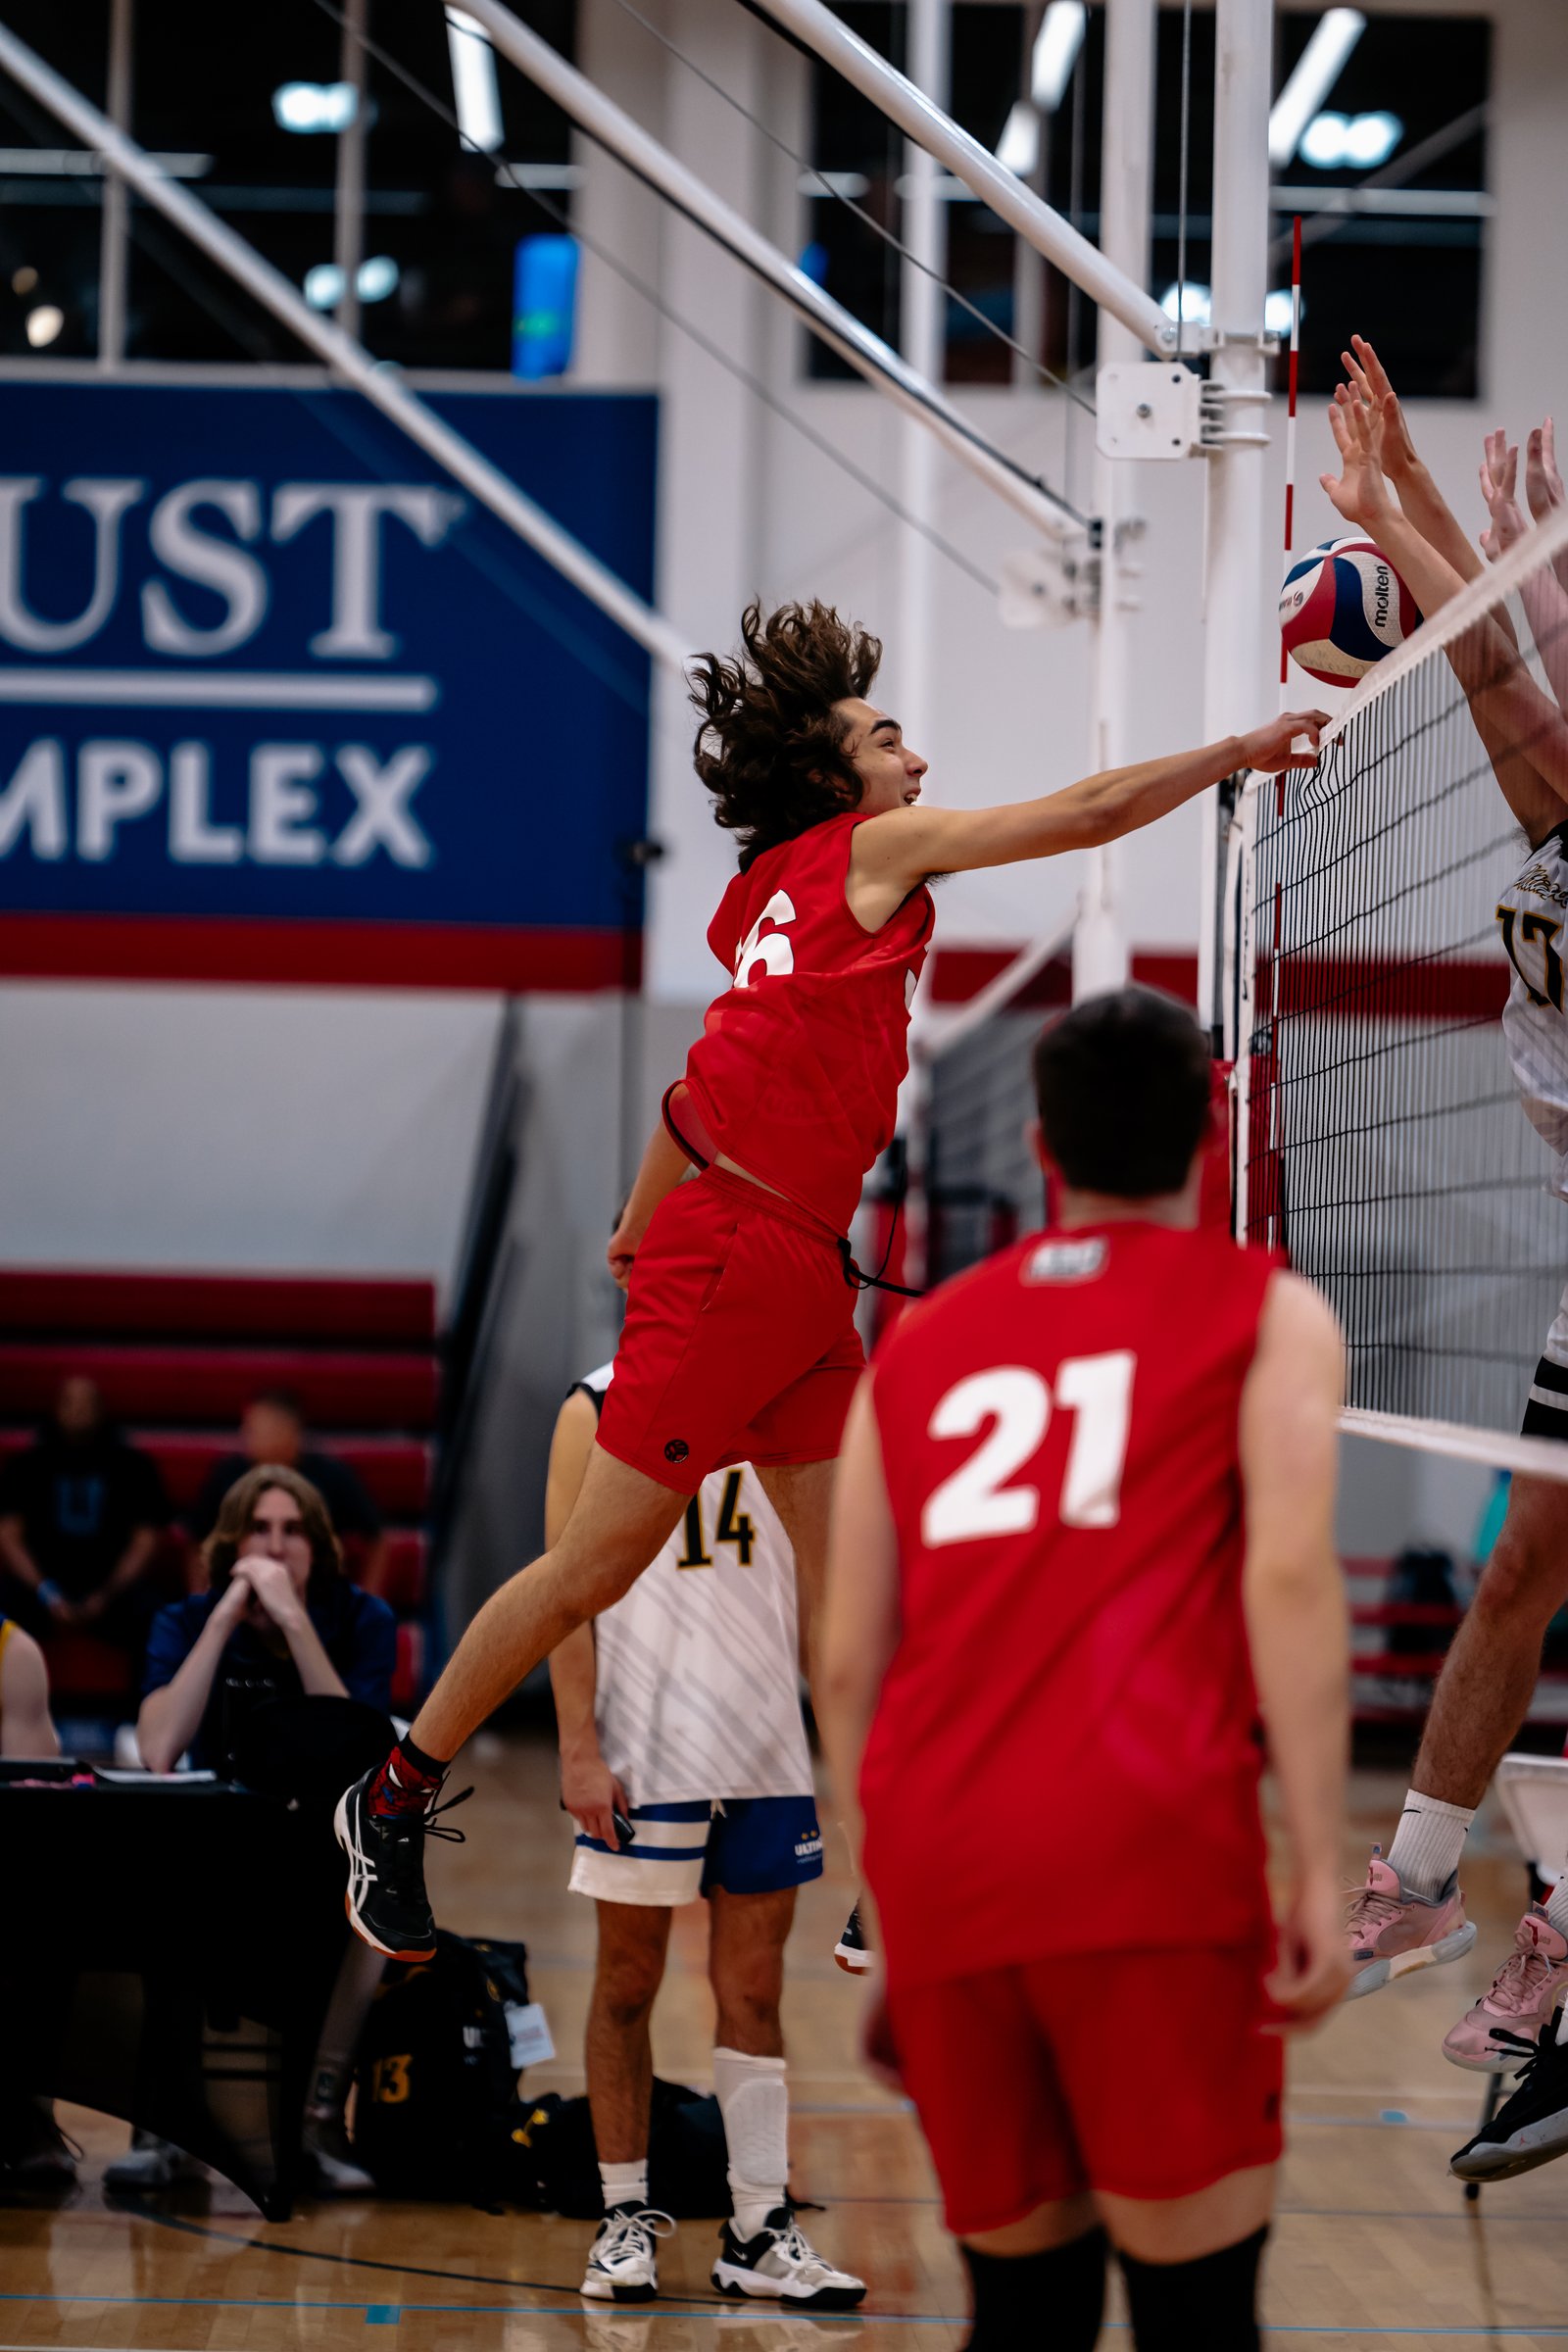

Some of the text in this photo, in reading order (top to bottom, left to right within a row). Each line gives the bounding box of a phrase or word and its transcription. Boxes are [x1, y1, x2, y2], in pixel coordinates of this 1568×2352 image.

[0, 475, 455, 661] UST
[1374, 565, 1389, 628] molten
[734, 889, 796, 989] 6
[1495, 904, 1564, 1015] 17
[921, 1348, 1137, 1548] 21
[676, 1469, 757, 1570] 14
[372, 2054, 413, 2103] 13
